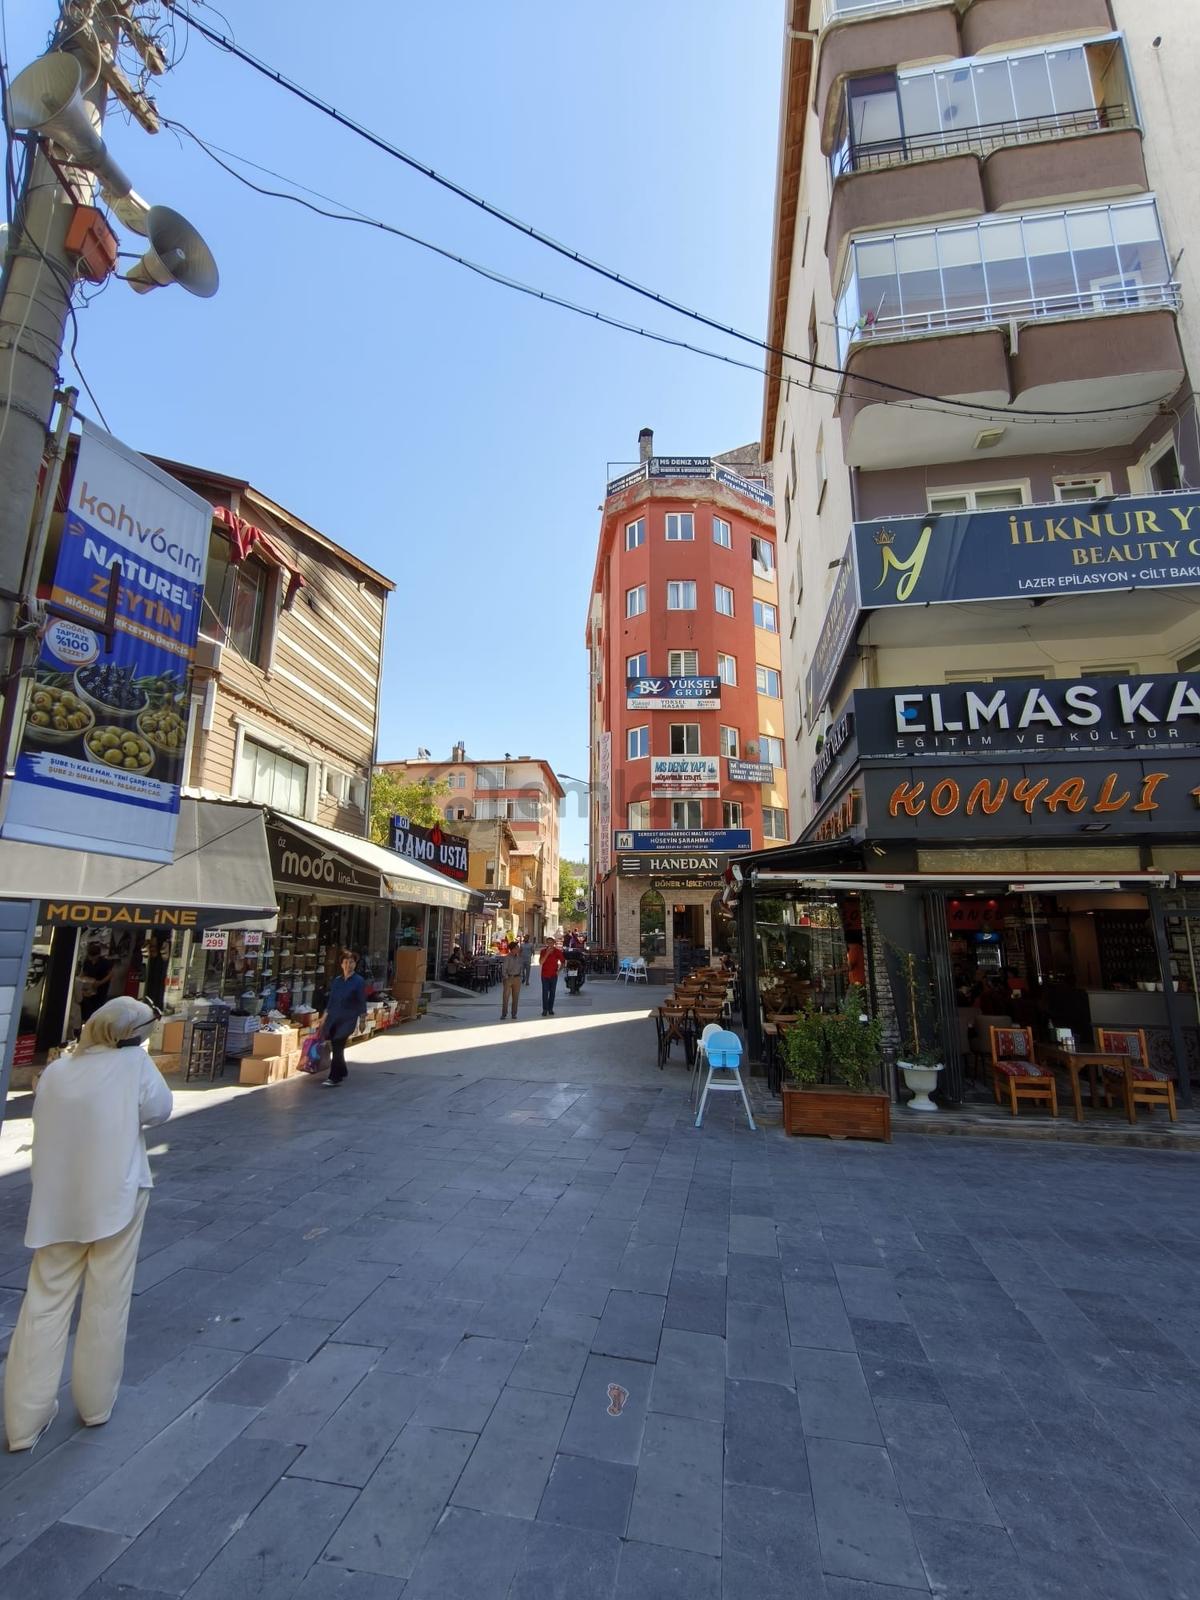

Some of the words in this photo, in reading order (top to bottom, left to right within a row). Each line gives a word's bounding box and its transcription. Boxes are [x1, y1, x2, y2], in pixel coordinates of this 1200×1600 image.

[1008, 510, 1164, 545] İLKNUR
[1072, 540, 1181, 566] BEAUTY
[83, 538, 193, 610] NATUREL
[1018, 577, 1056, 590] LAZER
[1058, 571, 1128, 588] EPİLASYON
[1139, 567, 1167, 580] CİLT
[56, 628, 89, 643] TAPTAZE
[56, 635, 89, 652] %100
[670, 678, 718, 689] YÜKSEL
[894, 685, 1102, 733] ELMAS
[897, 736, 992, 748] EĞİTİM
[1016, 734, 1044, 744] VE
[1070, 728, 1179, 742] KÜLTÜR
[76, 764, 95, 774] KALE
[690, 760, 706, 772] YAPI
[889, 772, 1169, 817] KONYALI
[395, 829, 434, 860] RAMO
[440, 844, 468, 871] USTA
[281, 850, 335, 882] moda
[650, 858, 718, 870] HANEDAN
[206, 938, 224, 947] 299
